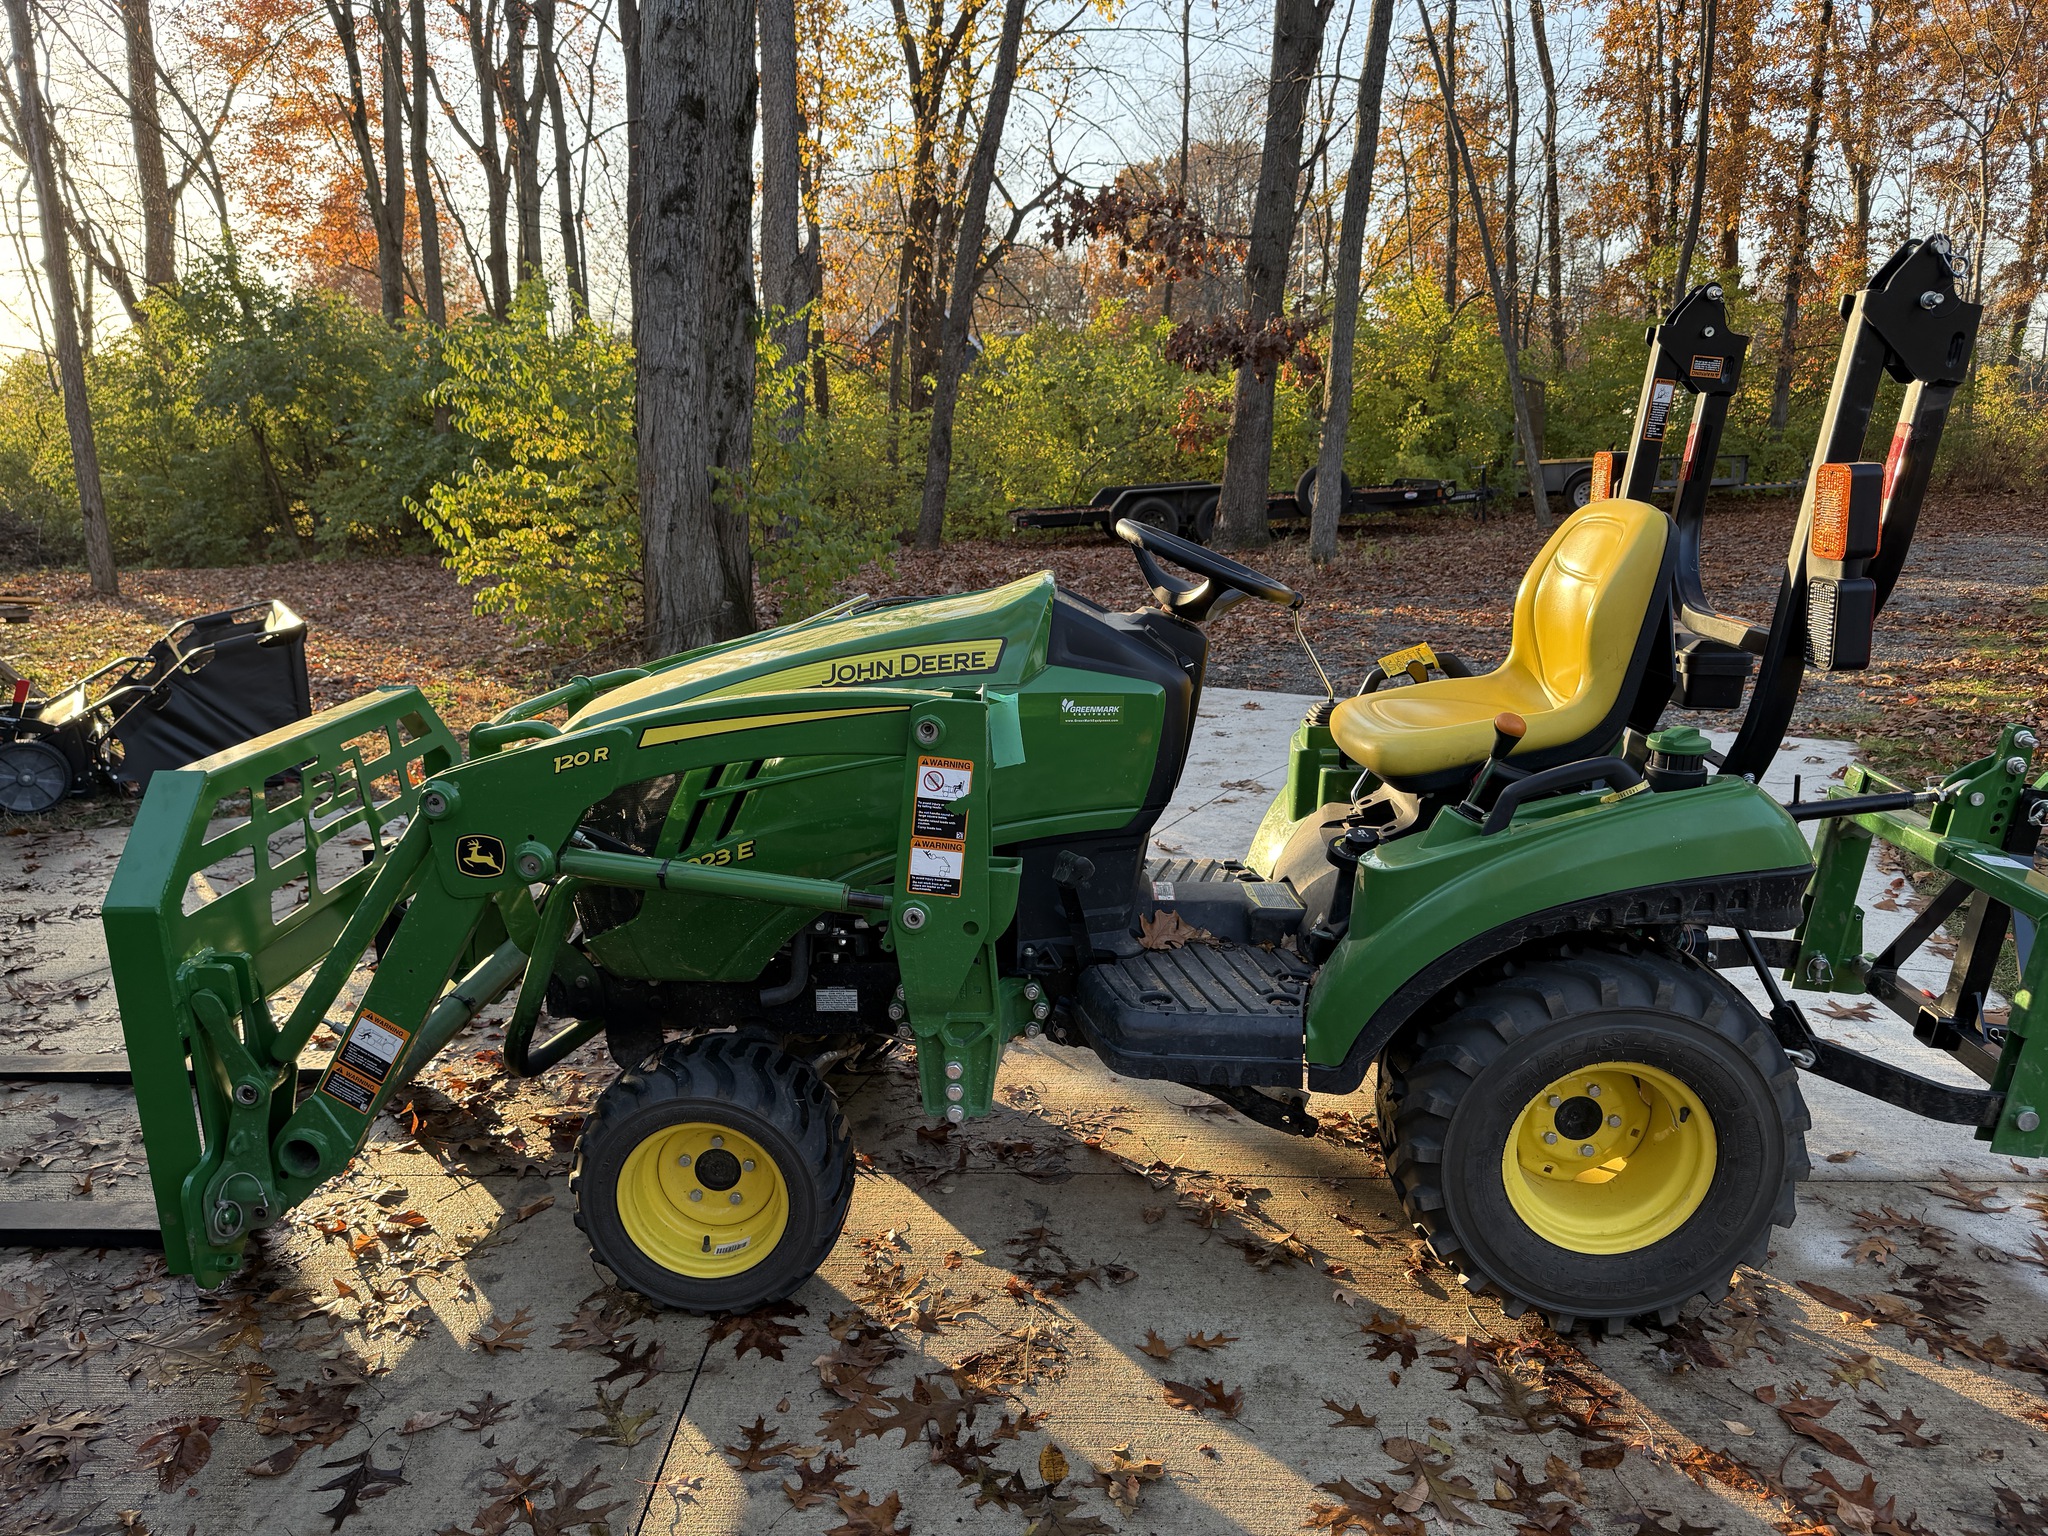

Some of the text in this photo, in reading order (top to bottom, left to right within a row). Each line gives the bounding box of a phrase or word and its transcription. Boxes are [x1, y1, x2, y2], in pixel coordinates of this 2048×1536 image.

[822, 652, 986, 684] JOHN DEERE
[554, 746, 608, 774] 120 R
[930, 759, 970, 769] WARNING
[738, 840, 754, 860] E
[922, 840, 962, 850] WARNING
[374, 1018, 404, 1037] WARNING
[1498, 1031, 1678, 1108] CARLISLE
[346, 1070, 374, 1090] WARNING
